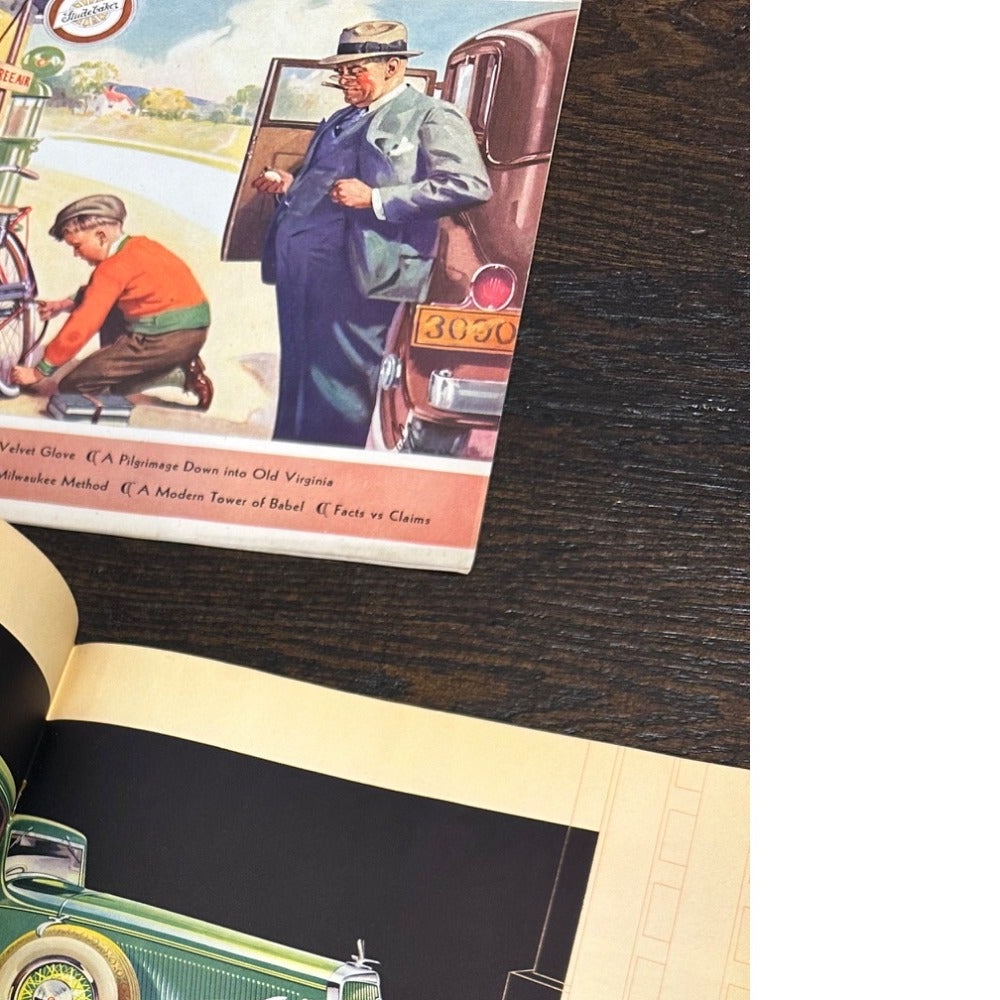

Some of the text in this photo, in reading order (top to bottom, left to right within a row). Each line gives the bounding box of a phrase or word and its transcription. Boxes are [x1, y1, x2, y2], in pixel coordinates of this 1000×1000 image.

[61, 2, 119, 23] Studebaker
[15, 74, 31, 87] AIR
[0, 441, 36, 456] Velvet
[40, 446, 76, 460] Glove
[102, 452, 114, 464] A
[119, 454, 179, 473] Pilgrimage
[183, 460, 220, 476] Down
[224, 465, 247, 479] into
[252, 467, 279, 482] Old
[285, 472, 334, 488] Virginia
[61, 476, 110, 492] Method
[137, 484, 150, 497] A
[154, 486, 205, 502] Modern
[210, 491, 247, 507] Tower
[251, 496, 267, 509] of
[269, 497, 305, 513] Babel
[333, 504, 365, 519] Facts
[370, 511, 383, 521] vs
[389, 511, 432, 526] Claims
